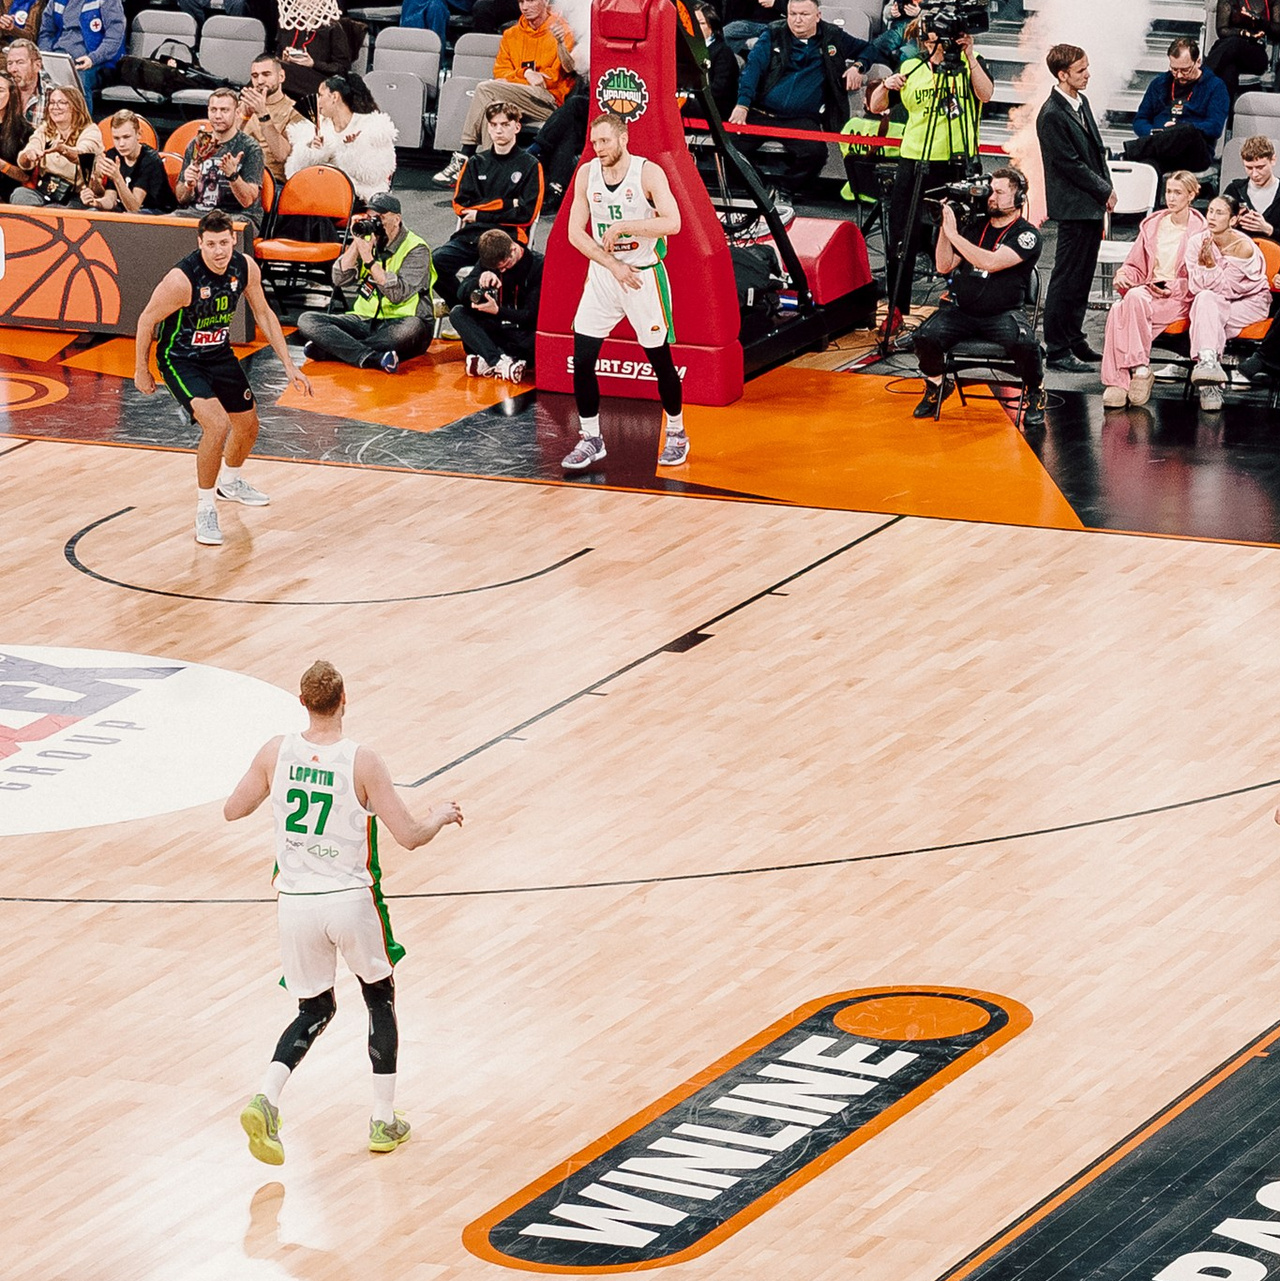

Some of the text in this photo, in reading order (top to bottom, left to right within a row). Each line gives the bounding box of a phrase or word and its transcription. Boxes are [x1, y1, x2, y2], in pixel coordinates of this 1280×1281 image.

[603, 89, 641, 104] УРАЛМАШ
[608, 205, 623, 220] 13
[215, 296, 228, 312] 10
[289, 764, 335, 787] LOPATIN
[285, 788, 334, 836] 27
[518, 1034, 919, 1248] WINLINE
